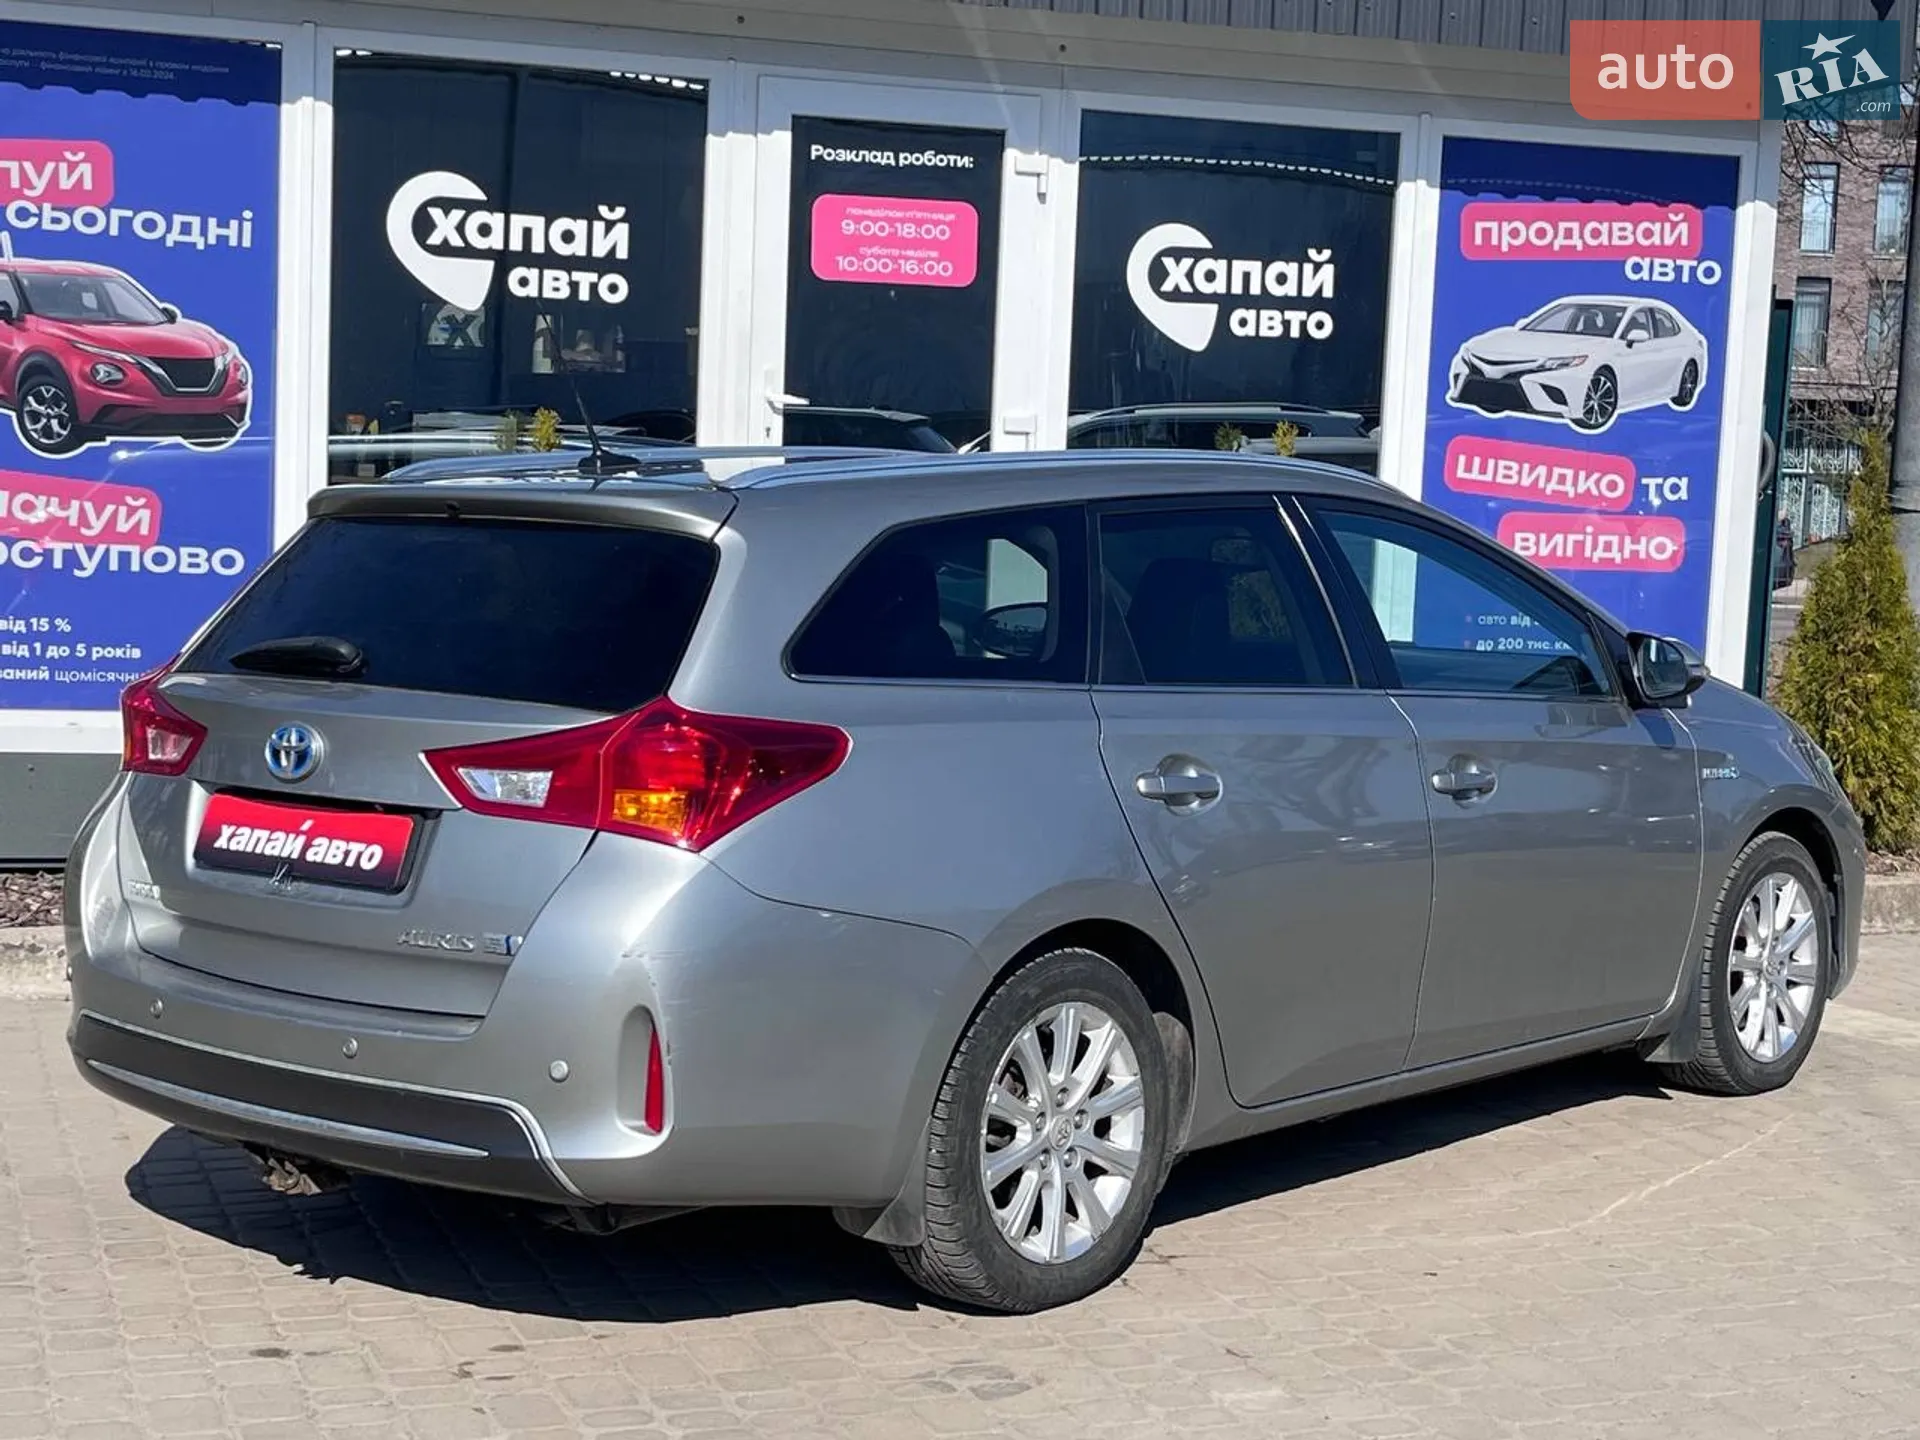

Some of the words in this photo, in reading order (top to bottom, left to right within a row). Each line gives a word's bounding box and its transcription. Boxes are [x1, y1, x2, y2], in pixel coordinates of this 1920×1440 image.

[810, 144, 896, 167] Розклад
[899, 150, 975, 168] роботи:
[5, 200, 254, 250] сьогодні
[424, 204, 630, 260] хапай
[841, 219, 951, 241] 9:00-18:00
[1473, 213, 1689, 252] продавай
[836, 256, 953, 277] 10:00-16:00
[1160, 248, 1335, 298] хапай
[1624, 257, 1722, 285] авто
[507, 266, 630, 304] авто
[1229, 308, 1334, 340] авто
[1456, 454, 1626, 498] швидко
[1641, 475, 1689, 502] та
[1513, 526, 1675, 564] вигідно
[30, 617, 50, 632] 15
[54, 617, 72, 633] %
[1477, 615, 1508, 626] авто
[1511, 612, 1532, 627] від
[1, 640, 30, 659] від
[33, 642, 42, 656] 1
[46, 645, 71, 660] до
[75, 642, 87, 658] 5
[91, 643, 142, 661] років
[1476, 639, 1494, 652] до
[1498, 637, 1524, 650] 200
[305, 836, 384, 871] авто
